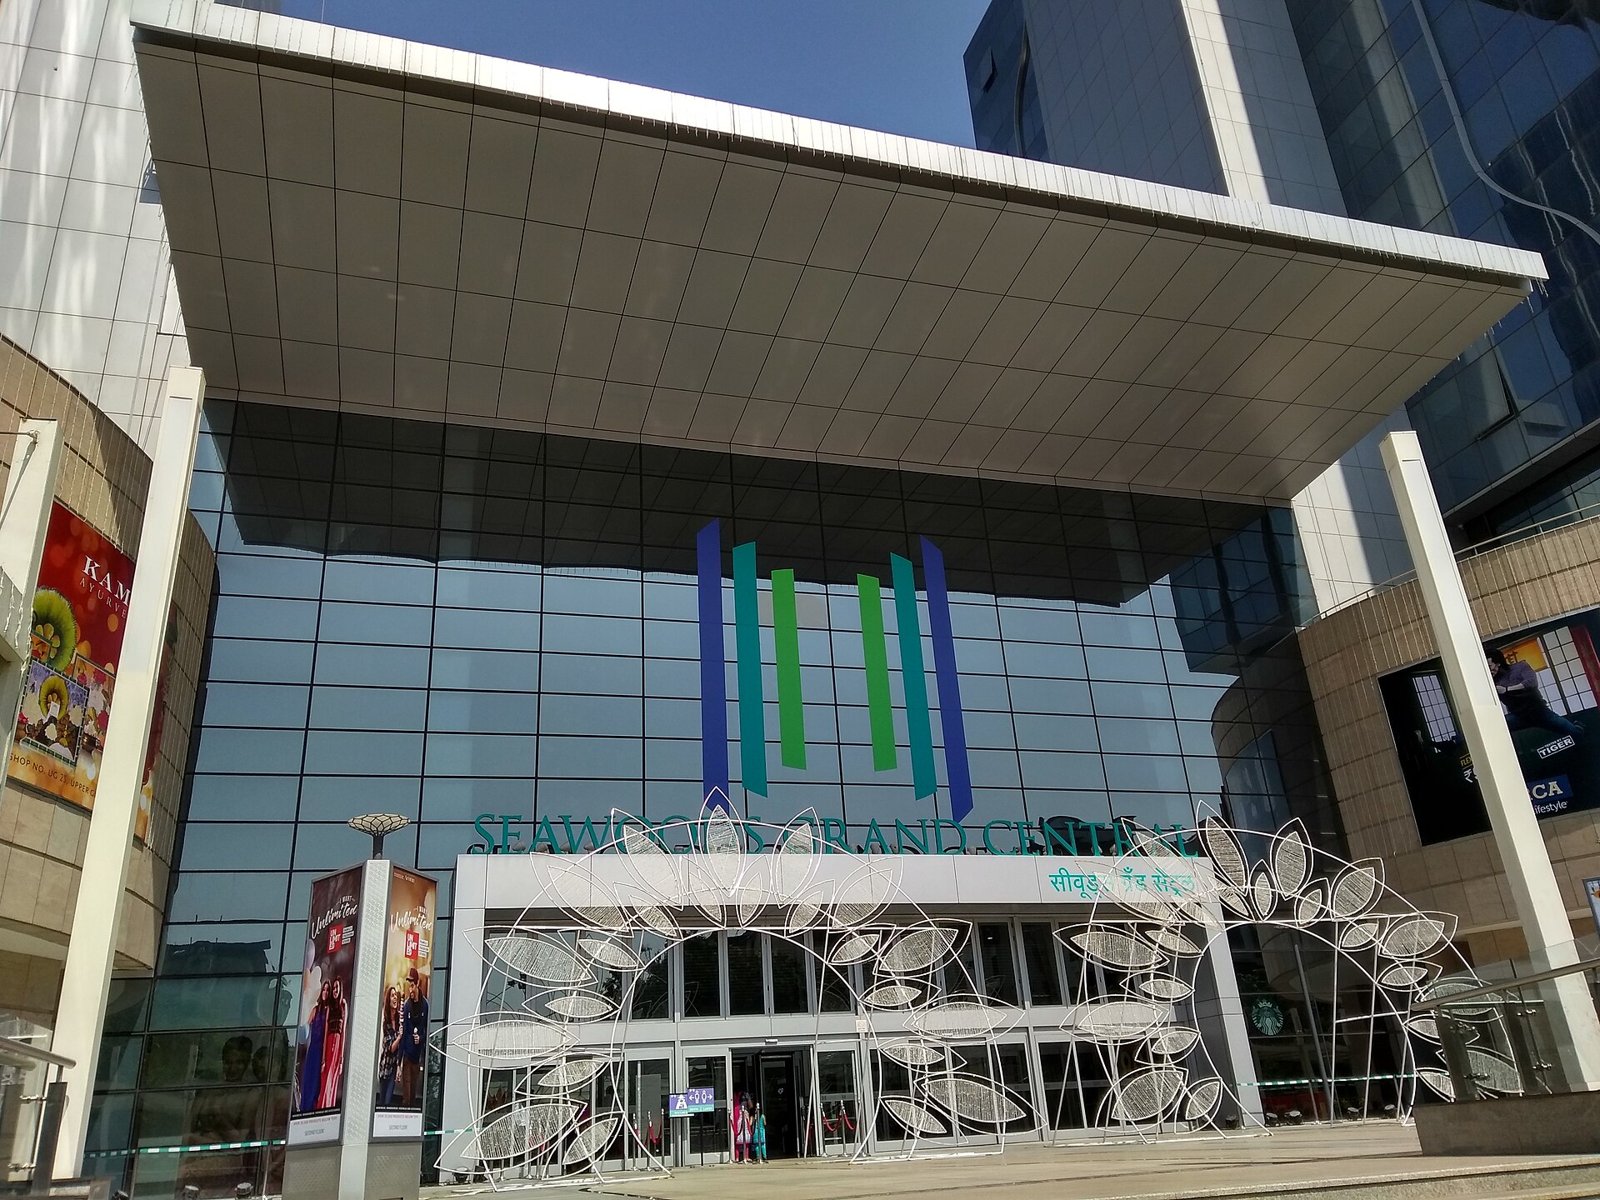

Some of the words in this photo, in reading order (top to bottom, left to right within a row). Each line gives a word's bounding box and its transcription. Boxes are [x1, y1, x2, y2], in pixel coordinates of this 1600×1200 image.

[79, 577, 127, 619] AYURVE
[82, 555, 131, 606] KAM
[1539, 738, 1573, 756] TIGER
[9, 752, 31, 767] SHOP
[32, 762, 45, 775] NO.
[70, 780, 90, 794] UPPER
[1530, 780, 1564, 801] CA
[1533, 800, 1568, 814] ifestyle
[782, 816, 967, 856] GRAND
[982, 818, 1199, 858] CENTRAL
[311, 902, 358, 940] Unlimited
